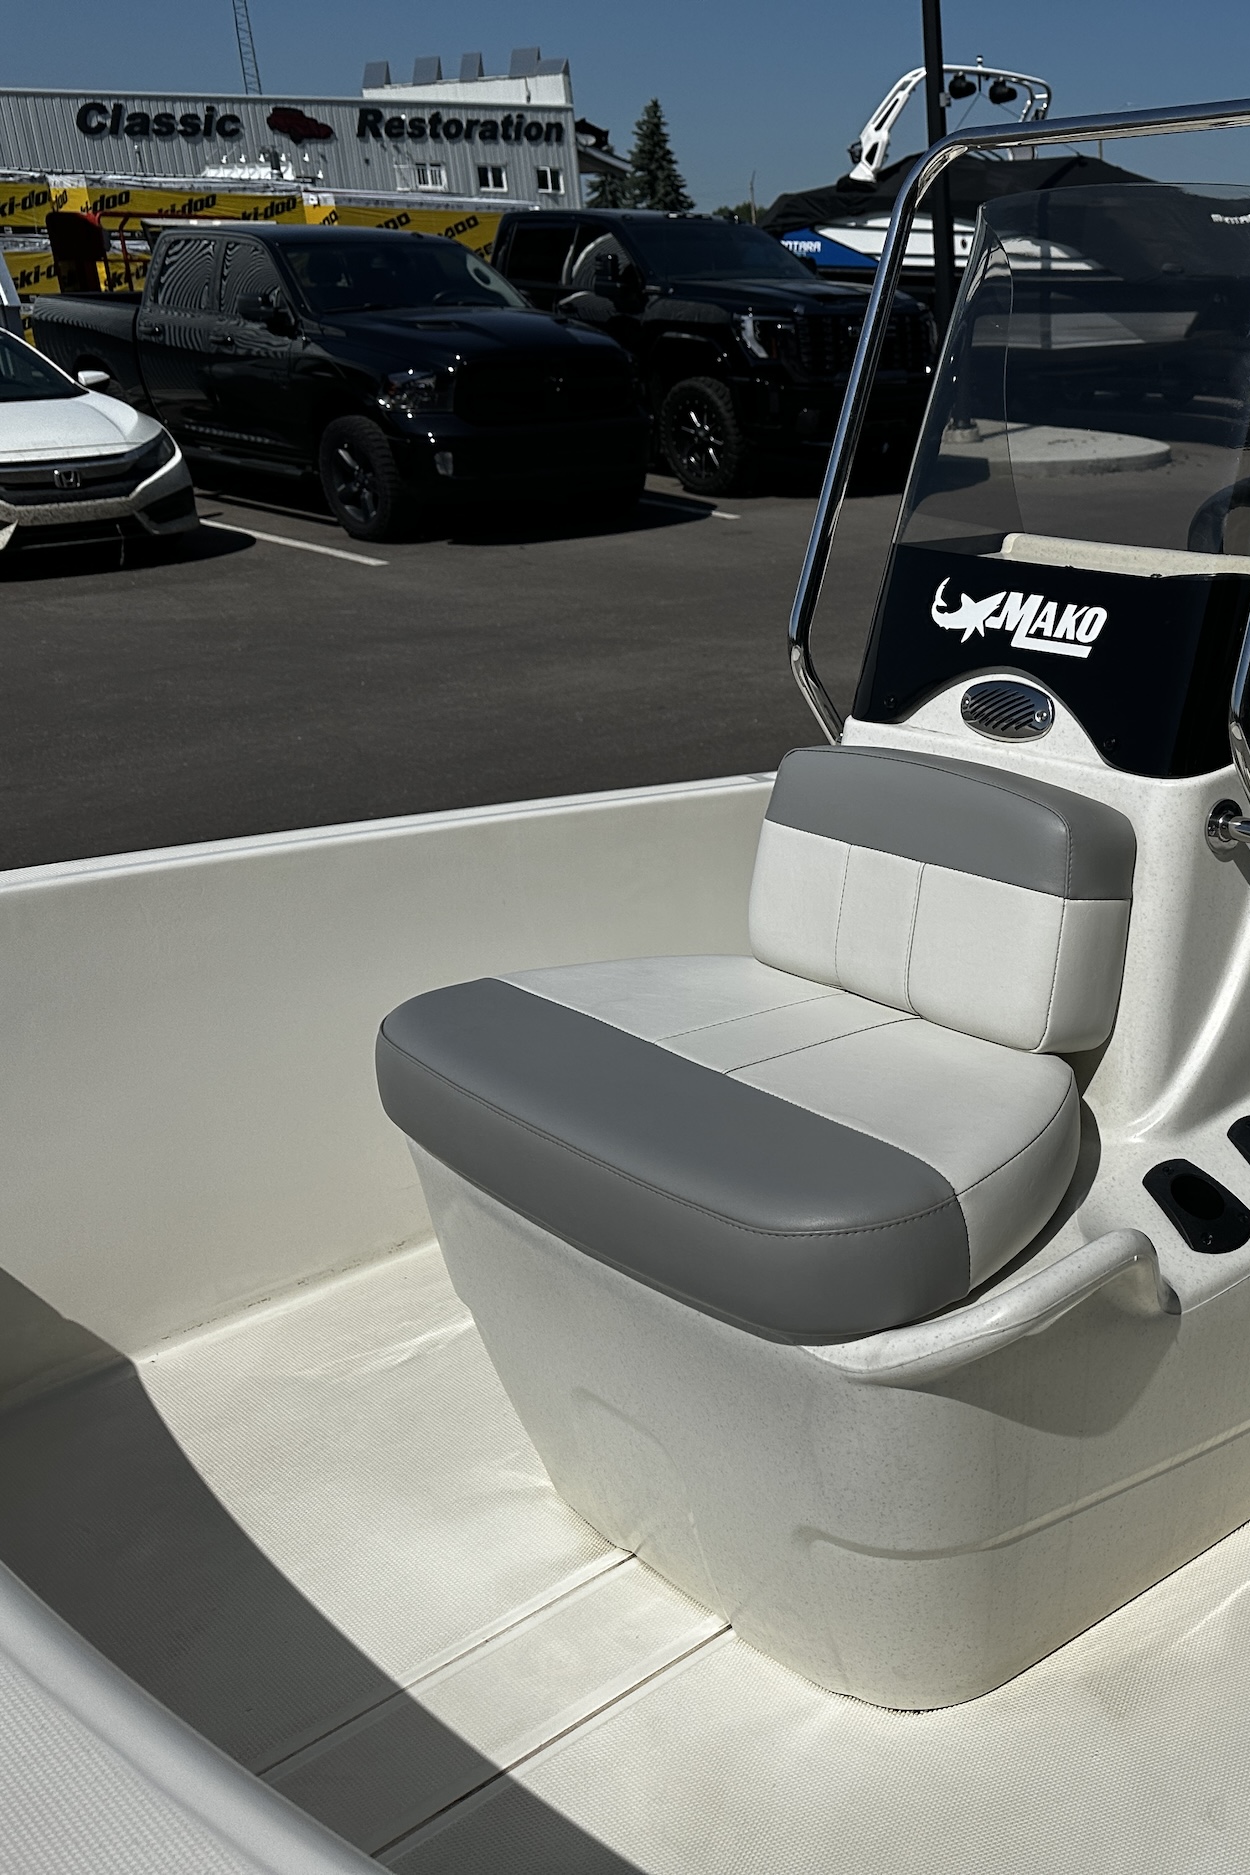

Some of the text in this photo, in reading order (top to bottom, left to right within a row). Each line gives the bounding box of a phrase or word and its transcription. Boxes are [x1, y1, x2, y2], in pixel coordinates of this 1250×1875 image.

[76, 102, 565, 143] Classic Restoration
[985, 591, 1108, 658] MAKO
